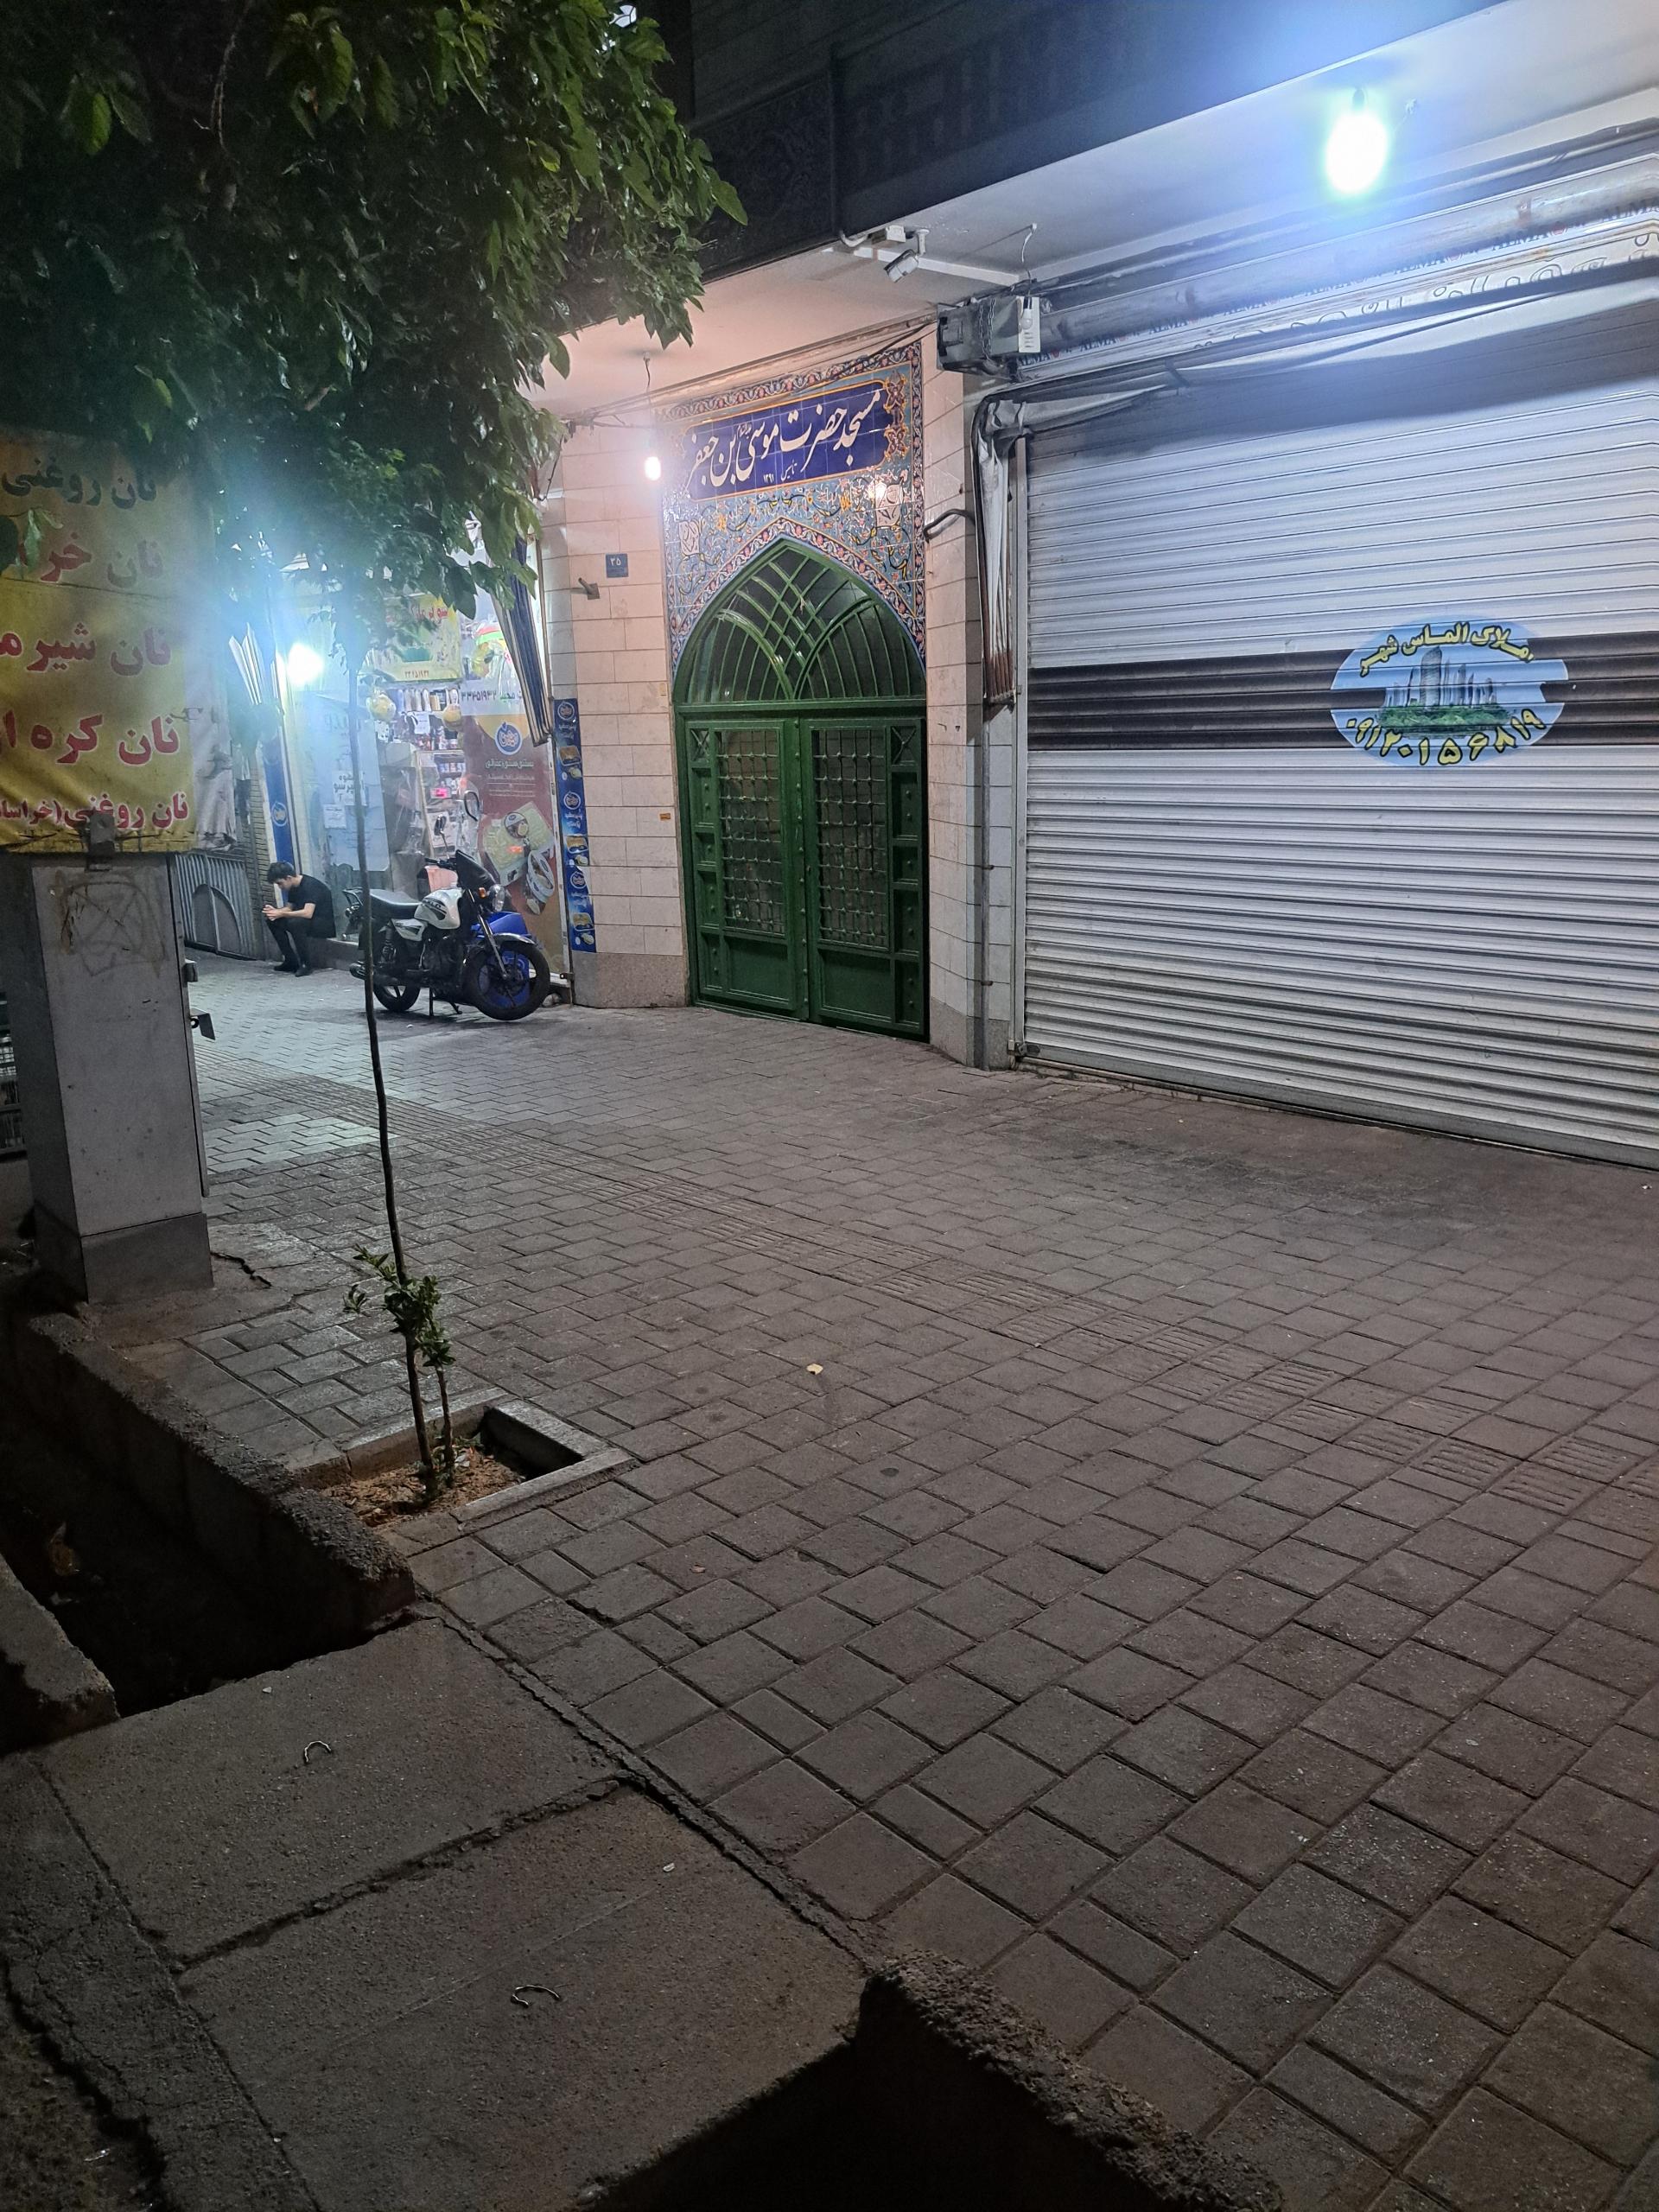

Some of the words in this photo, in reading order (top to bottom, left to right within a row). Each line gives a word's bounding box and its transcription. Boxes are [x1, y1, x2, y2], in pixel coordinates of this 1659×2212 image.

[735, 421, 779, 482] موسی
[779, 404, 848, 473] حضرت
[833, 389, 881, 467] مسجد
[2, 456, 101, 506] روغنی
[111, 466, 157, 510] نان
[684, 434, 719, 491] جعفر
[108, 537, 164, 588] نان
[0, 620, 97, 672] شیرم
[110, 623, 172, 677] نان
[1360, 634, 1400, 677] شهر
[1402, 622, 1469, 655] الماس
[0, 709, 17, 749] ا
[29, 713, 104, 766] کره
[118, 712, 181, 766] نان
[1345, 709, 1547, 766] ۰۹۱۲۰۱۵۶۸۱۹
[65, 792, 145, 830] روغنی
[151, 792, 189, 830] نان
